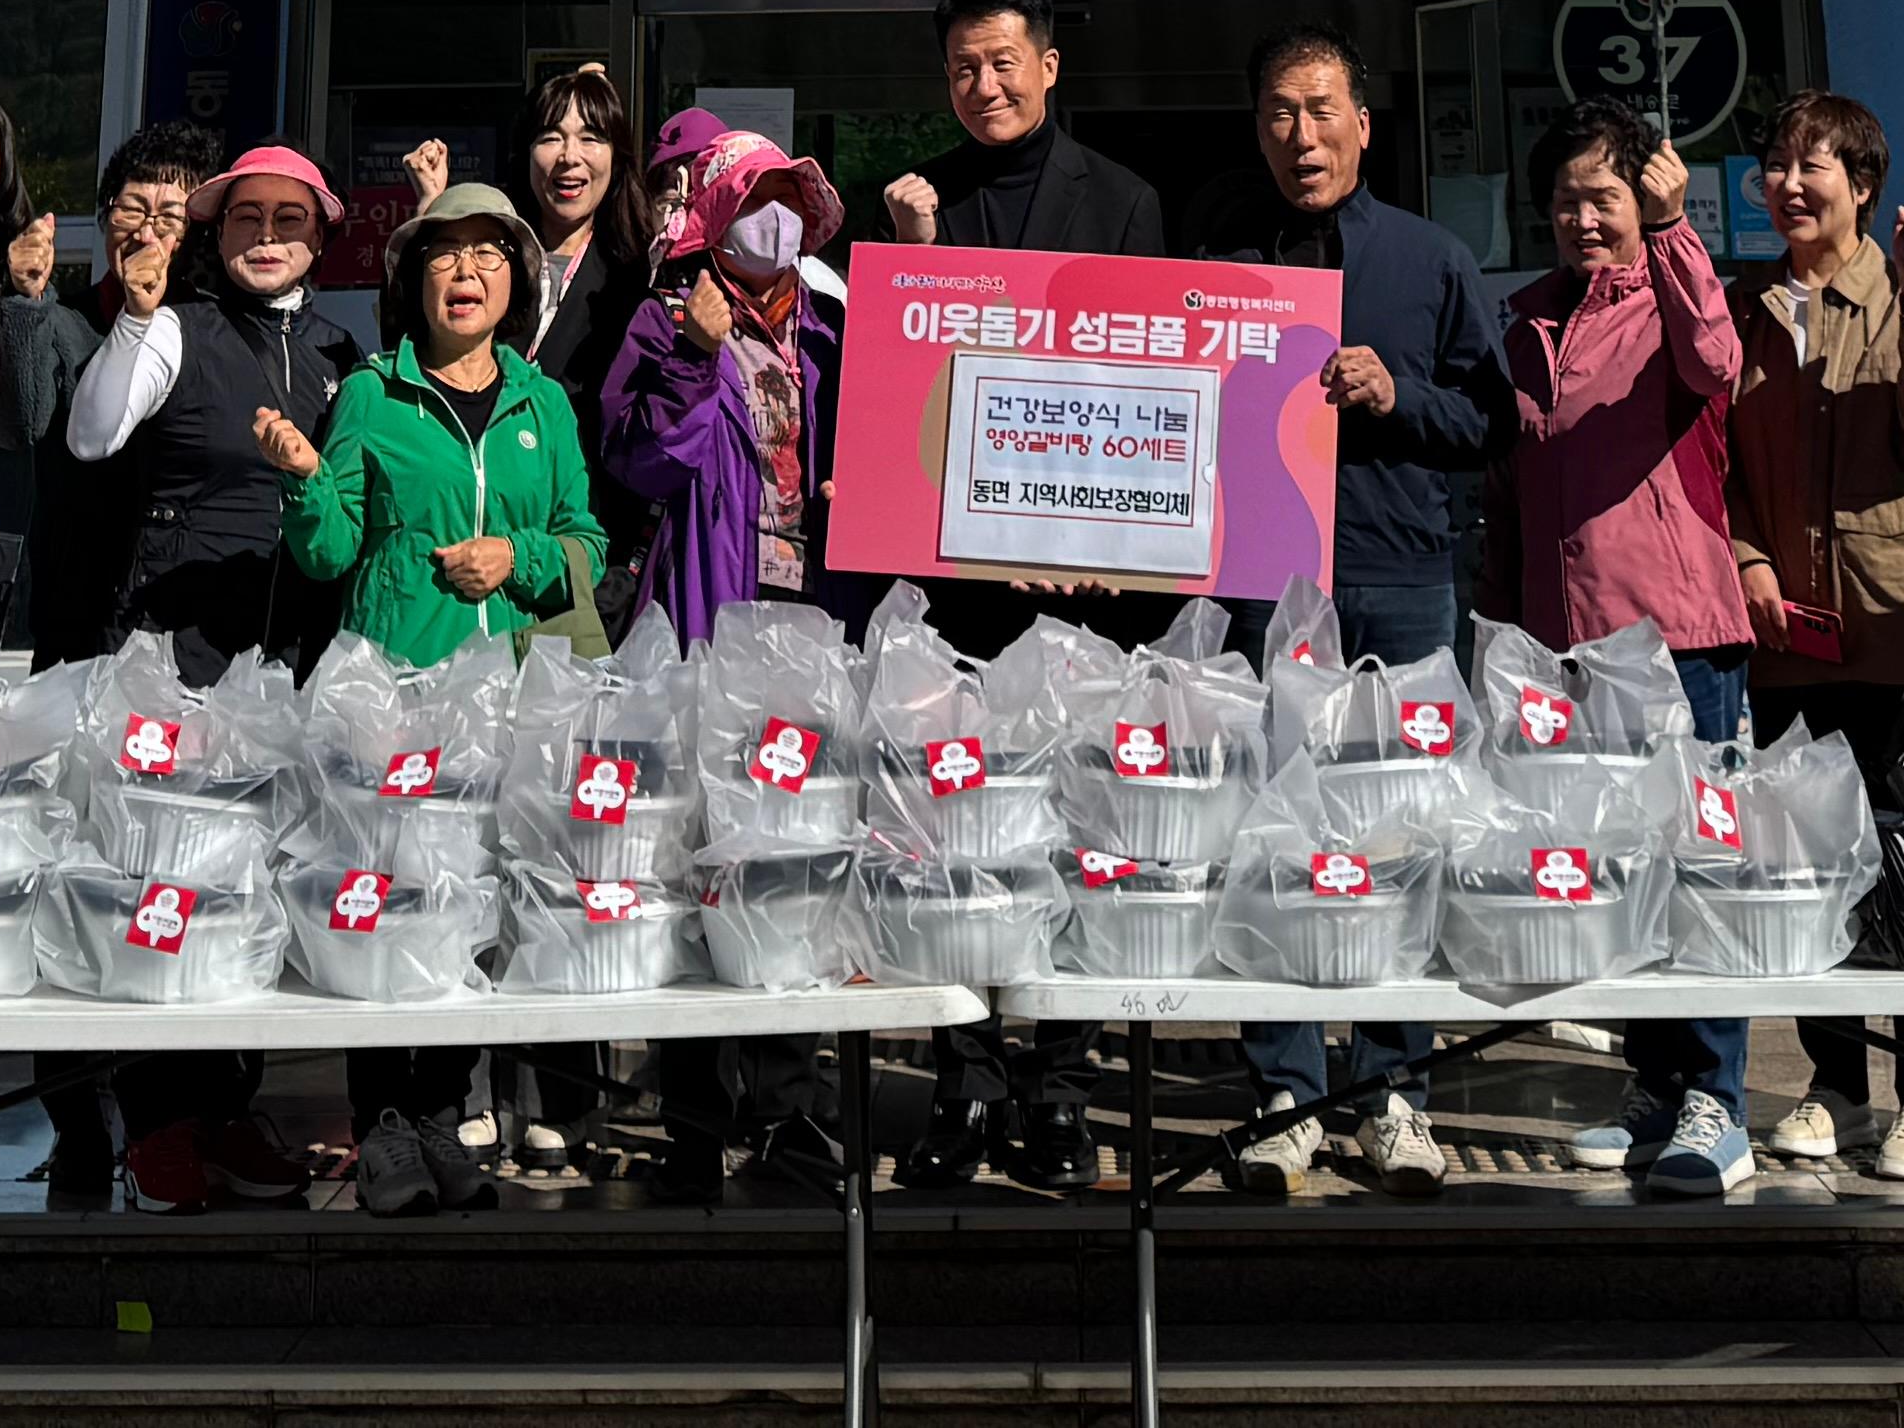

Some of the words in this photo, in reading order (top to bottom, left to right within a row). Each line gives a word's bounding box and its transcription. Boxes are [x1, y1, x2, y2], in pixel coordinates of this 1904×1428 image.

[1598, 35, 1702, 85] 37
[902, 301, 1056, 350] 이웃돕기
[1068, 310, 1186, 358] 성금품
[1198, 318, 1281, 364] 기탁
[987, 395, 1121, 430] 건강보양식
[1136, 404, 1189, 433] 나눔
[985, 427, 1093, 457] 영양갈비탕
[1102, 434, 1187, 463] 60세트
[972, 479, 1010, 504] 동면
[1018, 481, 1190, 517] 지역사회보장협의체
